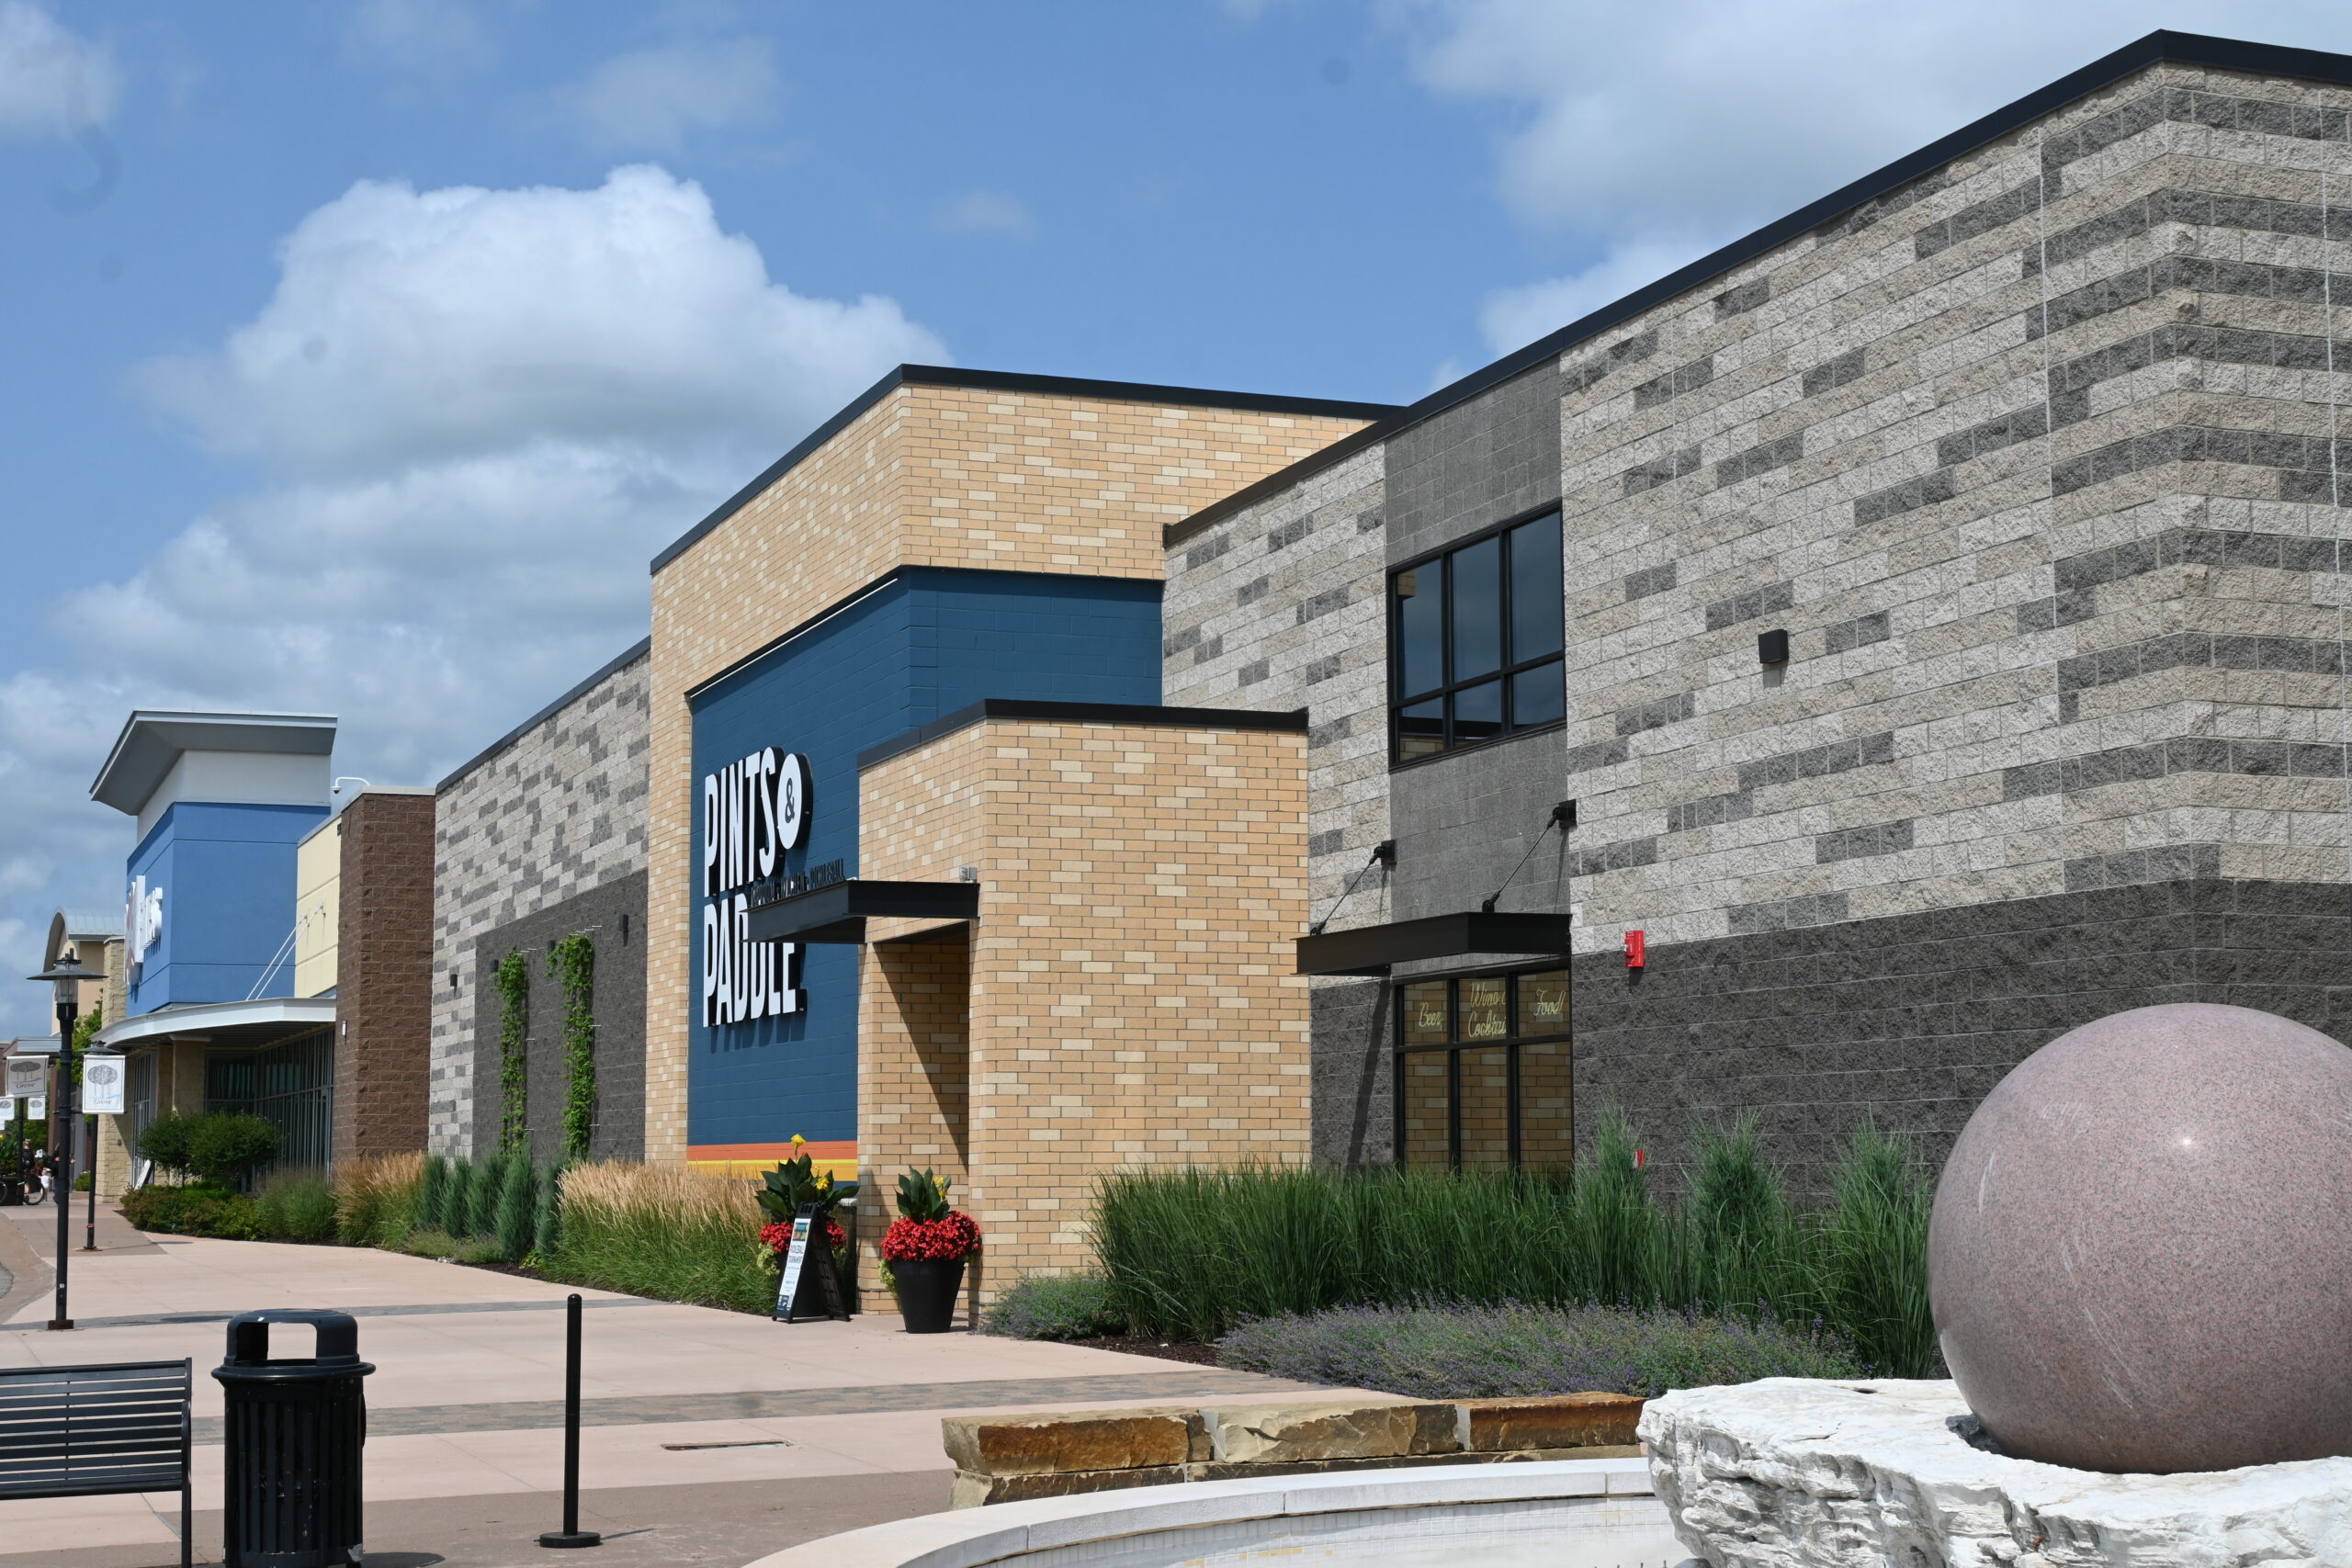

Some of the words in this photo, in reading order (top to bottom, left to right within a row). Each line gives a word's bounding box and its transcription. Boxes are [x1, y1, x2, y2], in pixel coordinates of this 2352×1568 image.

[703, 746, 776, 898] PINTS
[703, 893, 797, 1028] PADDLE
[1467, 1010, 1507, 1038] Cocktai
[1532, 988, 1566, 1016] Food
